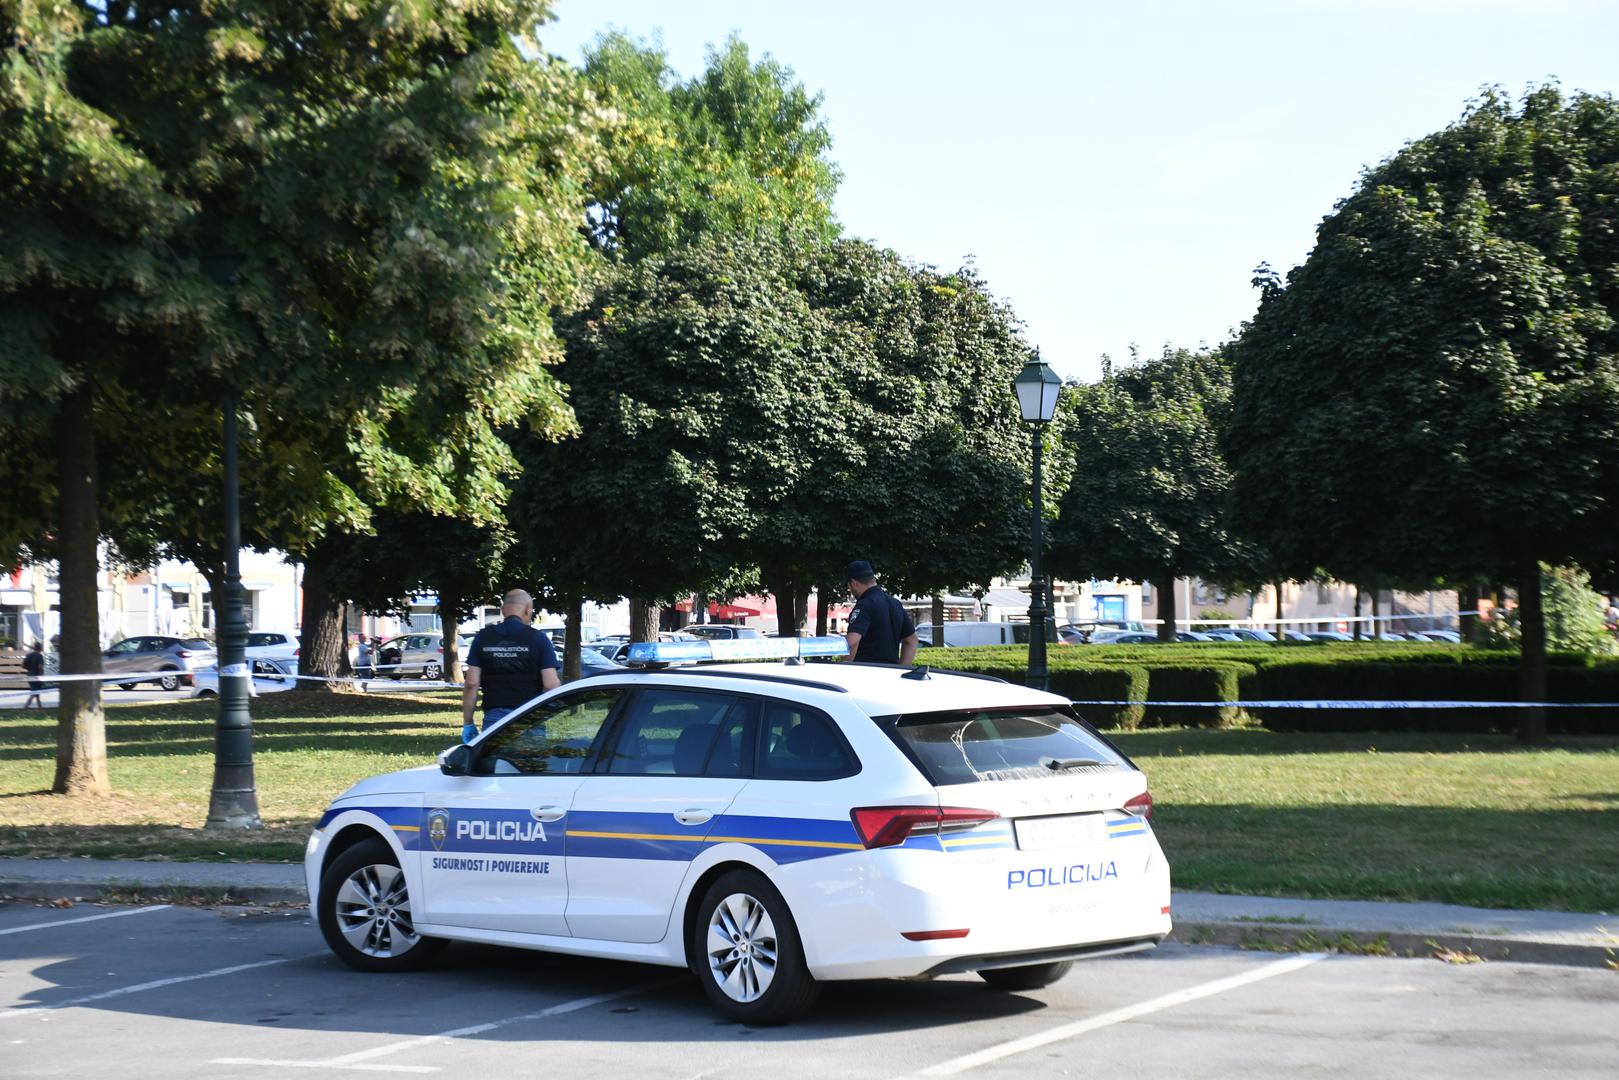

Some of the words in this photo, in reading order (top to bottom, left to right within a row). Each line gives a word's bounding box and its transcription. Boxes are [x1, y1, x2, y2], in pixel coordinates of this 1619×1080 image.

[456, 820, 548, 842] POLICIJA
[432, 857, 483, 872] SIGURNOST
[491, 860, 550, 874] POVJERENJE
[1007, 861, 1118, 889] POLICIJA
